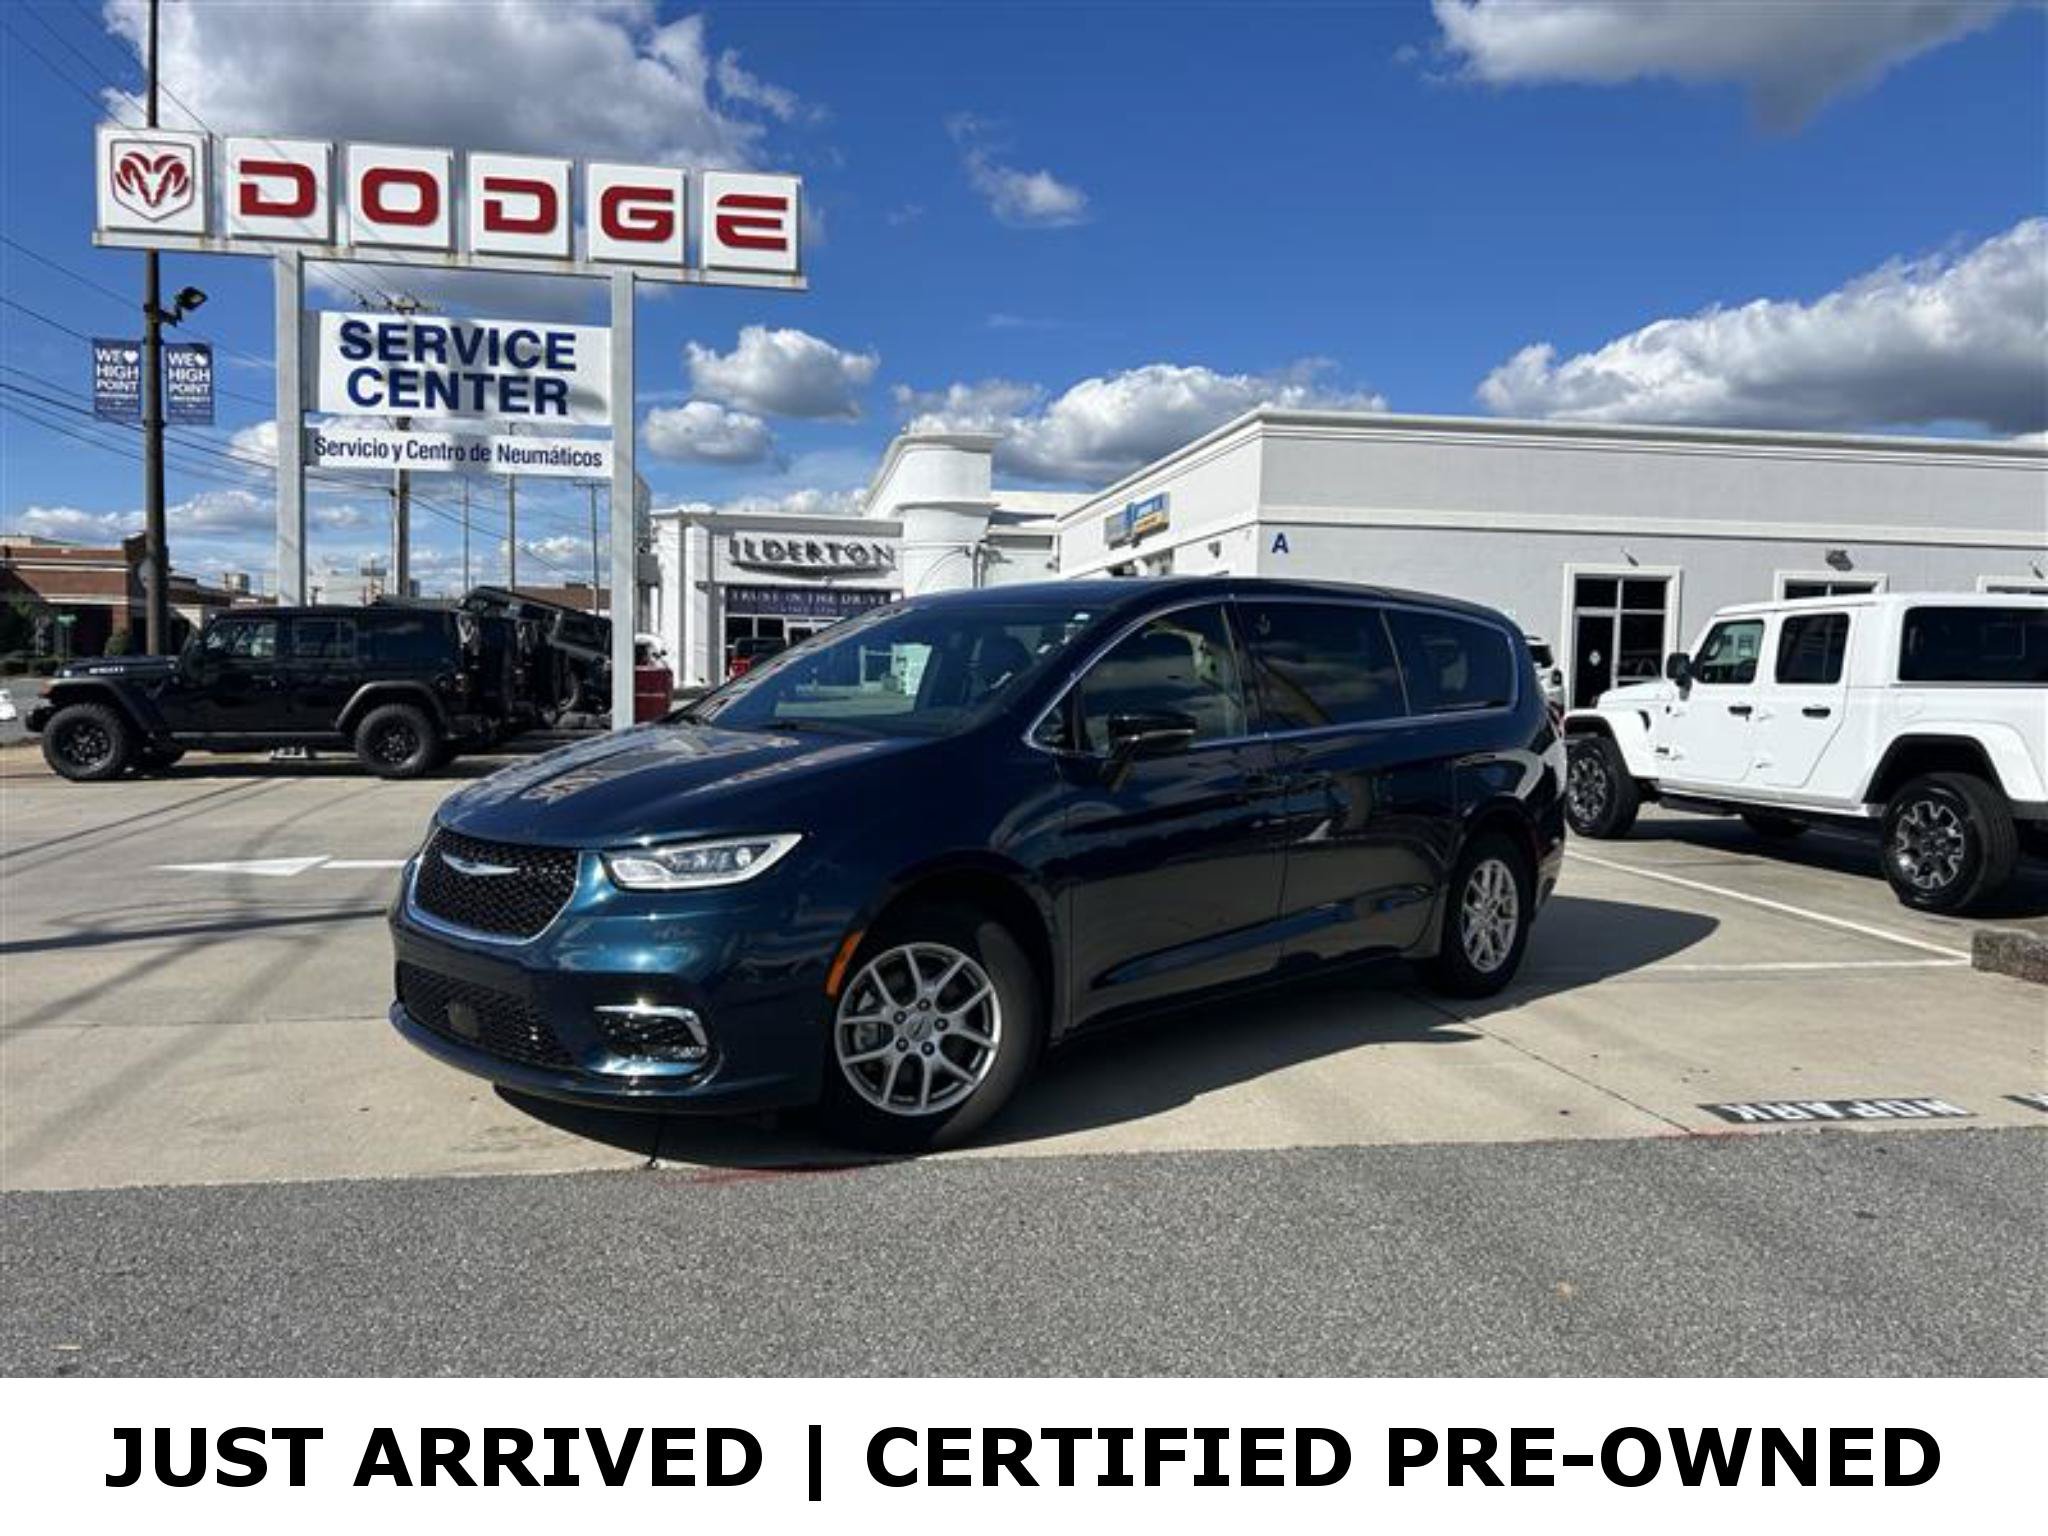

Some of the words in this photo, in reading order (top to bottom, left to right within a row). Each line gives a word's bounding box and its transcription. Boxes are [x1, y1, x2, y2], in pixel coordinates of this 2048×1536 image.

[239, 159, 788, 251] DODGE
[339, 319, 577, 371] SERVICE
[96, 348, 121, 362] WE
[168, 351, 195, 366] WE
[97, 363, 139, 379] HIGH
[168, 367, 210, 382] HIGH
[97, 379, 137, 391] POINT
[168, 382, 209, 395] POINT
[347, 366, 569, 415] CENTER
[314, 436, 388, 459] Servicio
[391, 443, 404, 462] y
[406, 439, 466, 462] Centro
[470, 442, 492, 463] de
[497, 443, 602, 467] Neumáticos
[1271, 532, 1289, 553] A
[729, 537, 896, 567] ILDERTON
